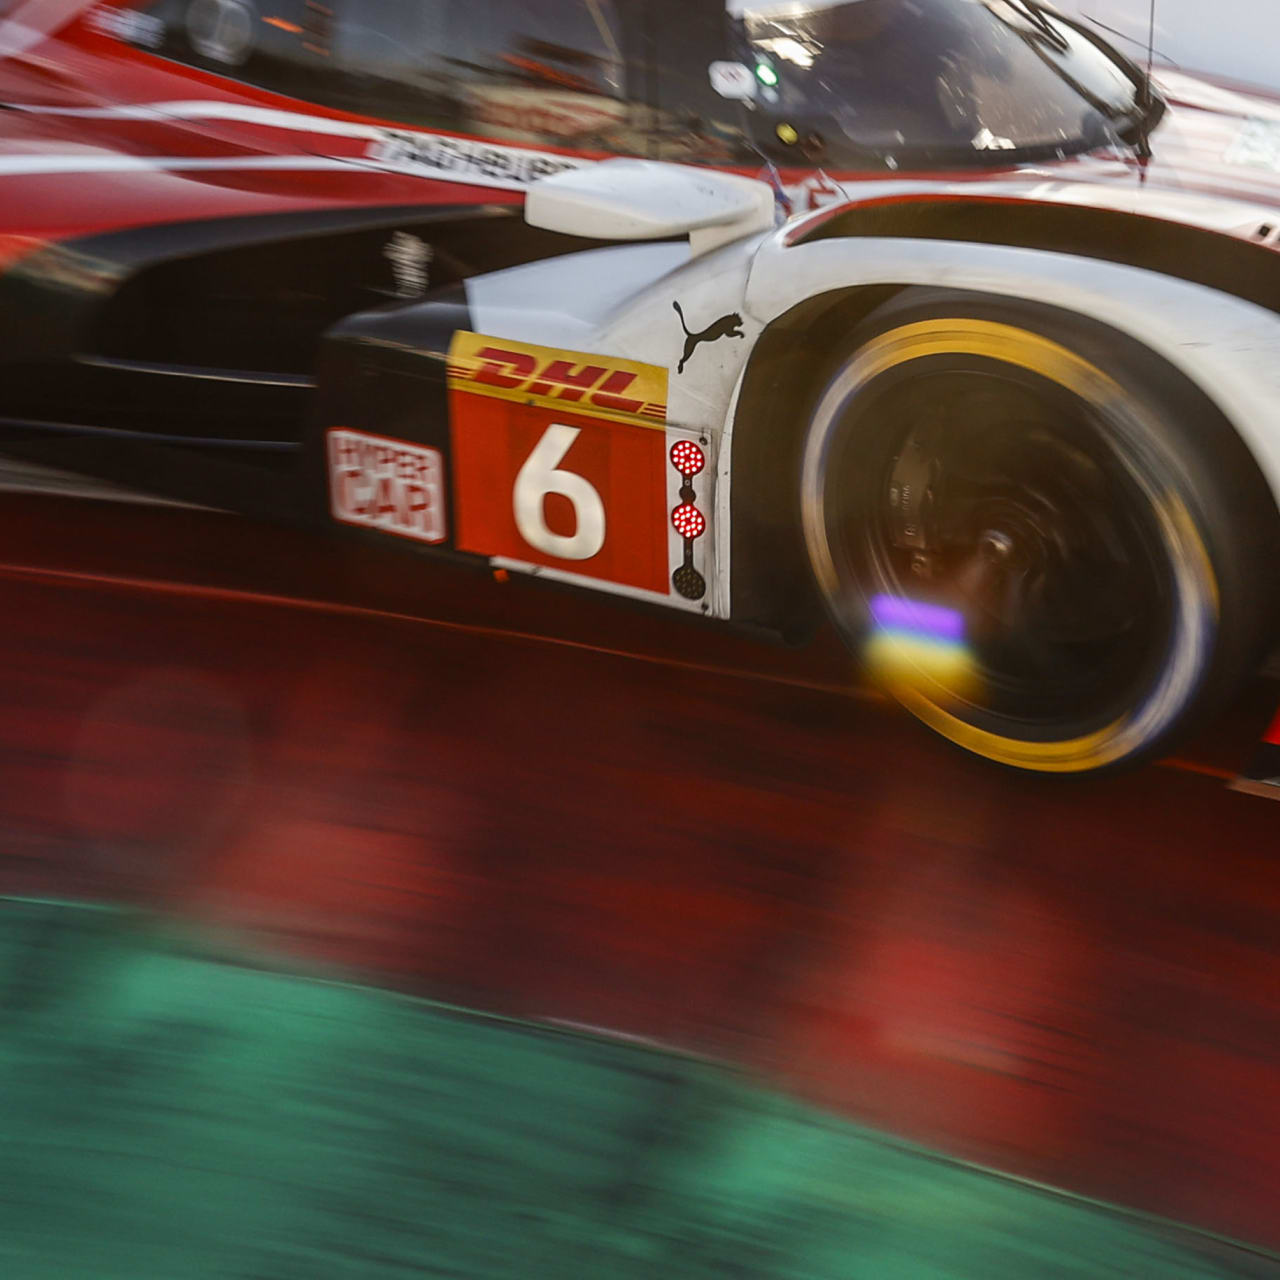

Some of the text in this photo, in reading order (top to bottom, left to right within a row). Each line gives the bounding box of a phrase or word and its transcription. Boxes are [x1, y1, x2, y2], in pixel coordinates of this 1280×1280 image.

[473, 348, 645, 413] DHL
[336, 471, 434, 533] CAR
[513, 423, 605, 560] 6
